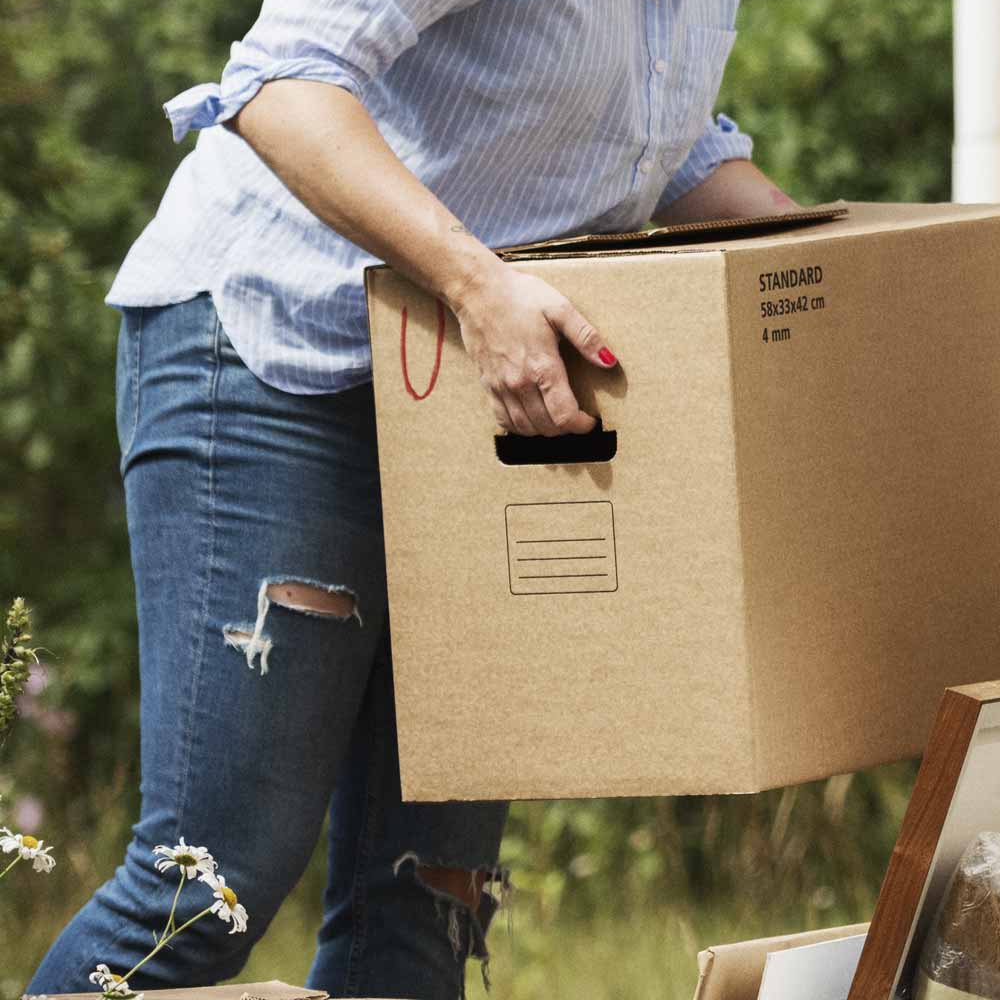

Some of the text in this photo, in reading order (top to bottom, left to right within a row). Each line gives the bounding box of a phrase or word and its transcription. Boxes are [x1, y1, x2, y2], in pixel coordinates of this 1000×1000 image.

[759, 266, 823, 292] STANDARD
[760, 295, 825, 318] 58x33x42 cm
[762, 328, 791, 343] 4 mm
